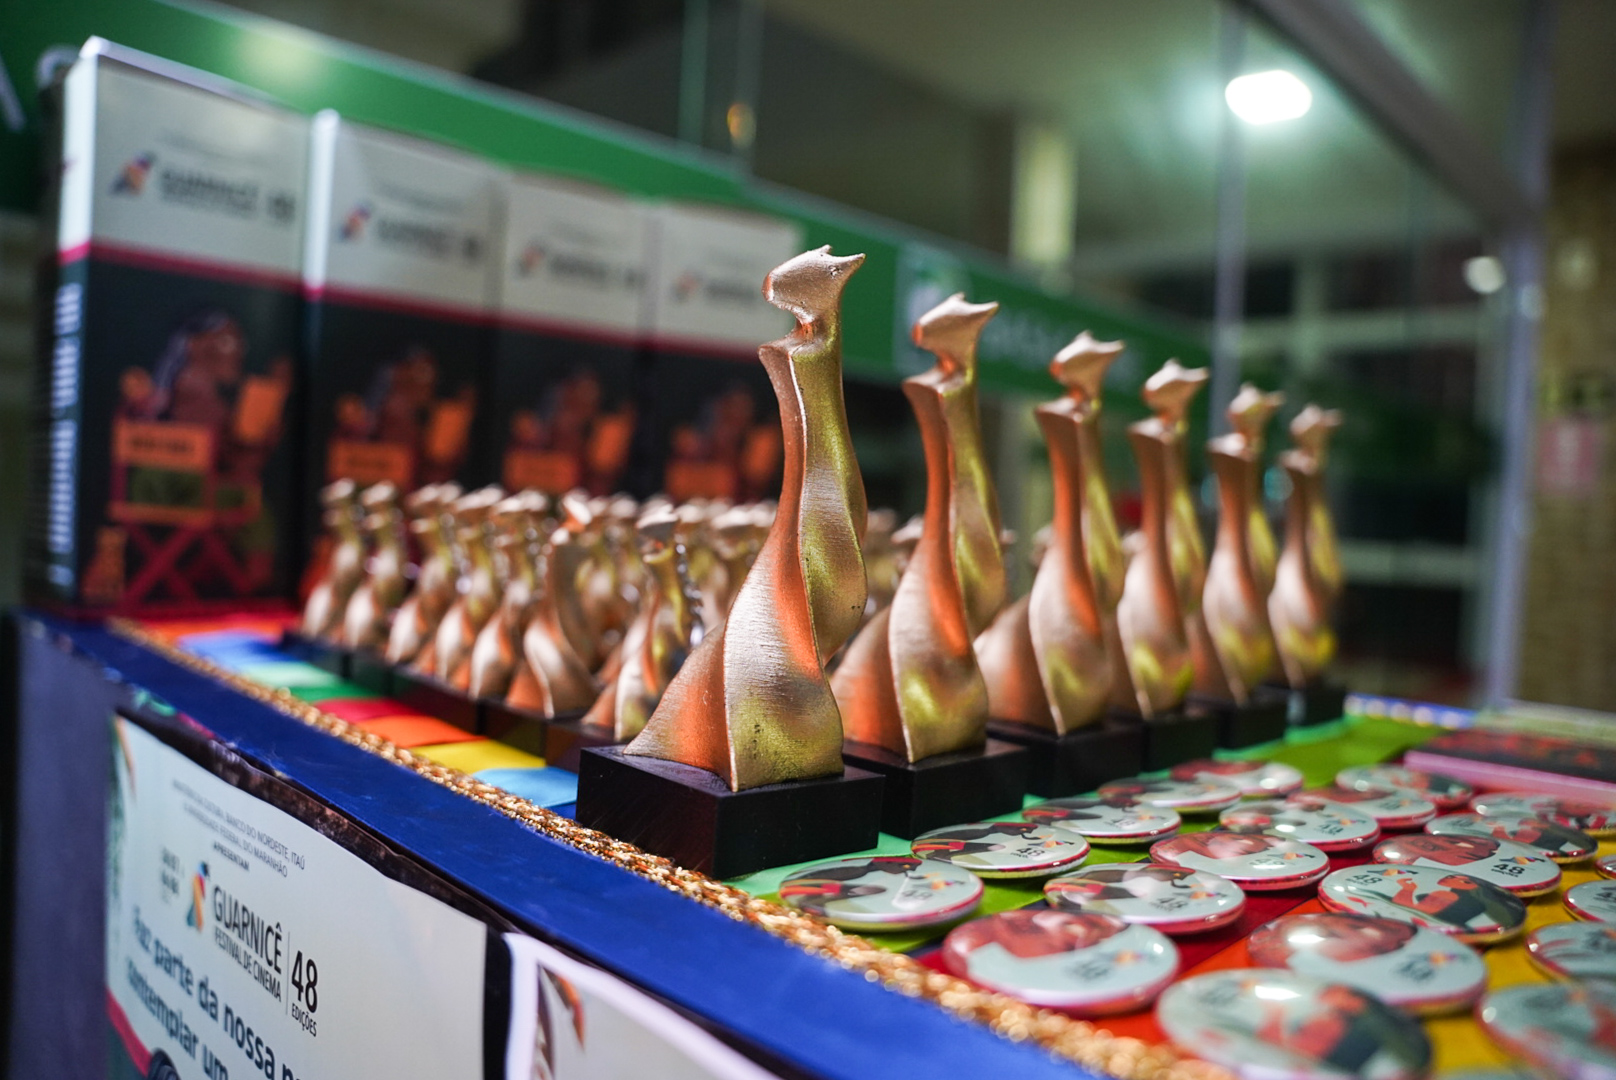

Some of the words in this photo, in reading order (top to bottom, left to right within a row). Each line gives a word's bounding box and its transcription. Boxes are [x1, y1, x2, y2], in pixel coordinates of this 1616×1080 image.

[253, 847, 288, 878] MARANHÃO
[257, 830, 290, 863] NORDESTE,
[291, 851, 306, 870] ITAÚ
[1493, 863, 1525, 875] 48
[1352, 874, 1383, 884] 48
[213, 884, 282, 975] GUARNICÊ
[214, 925, 242, 965] FESTIVAL
[243, 949, 252, 974] DE
[253, 960, 282, 1002] CINEMA
[291, 950, 318, 1013] 48
[153, 937, 194, 997] parte
[198, 974, 219, 1022] da
[223, 1003, 275, 1080] nossa
[291, 1003, 317, 1037] EDIÇÕES
